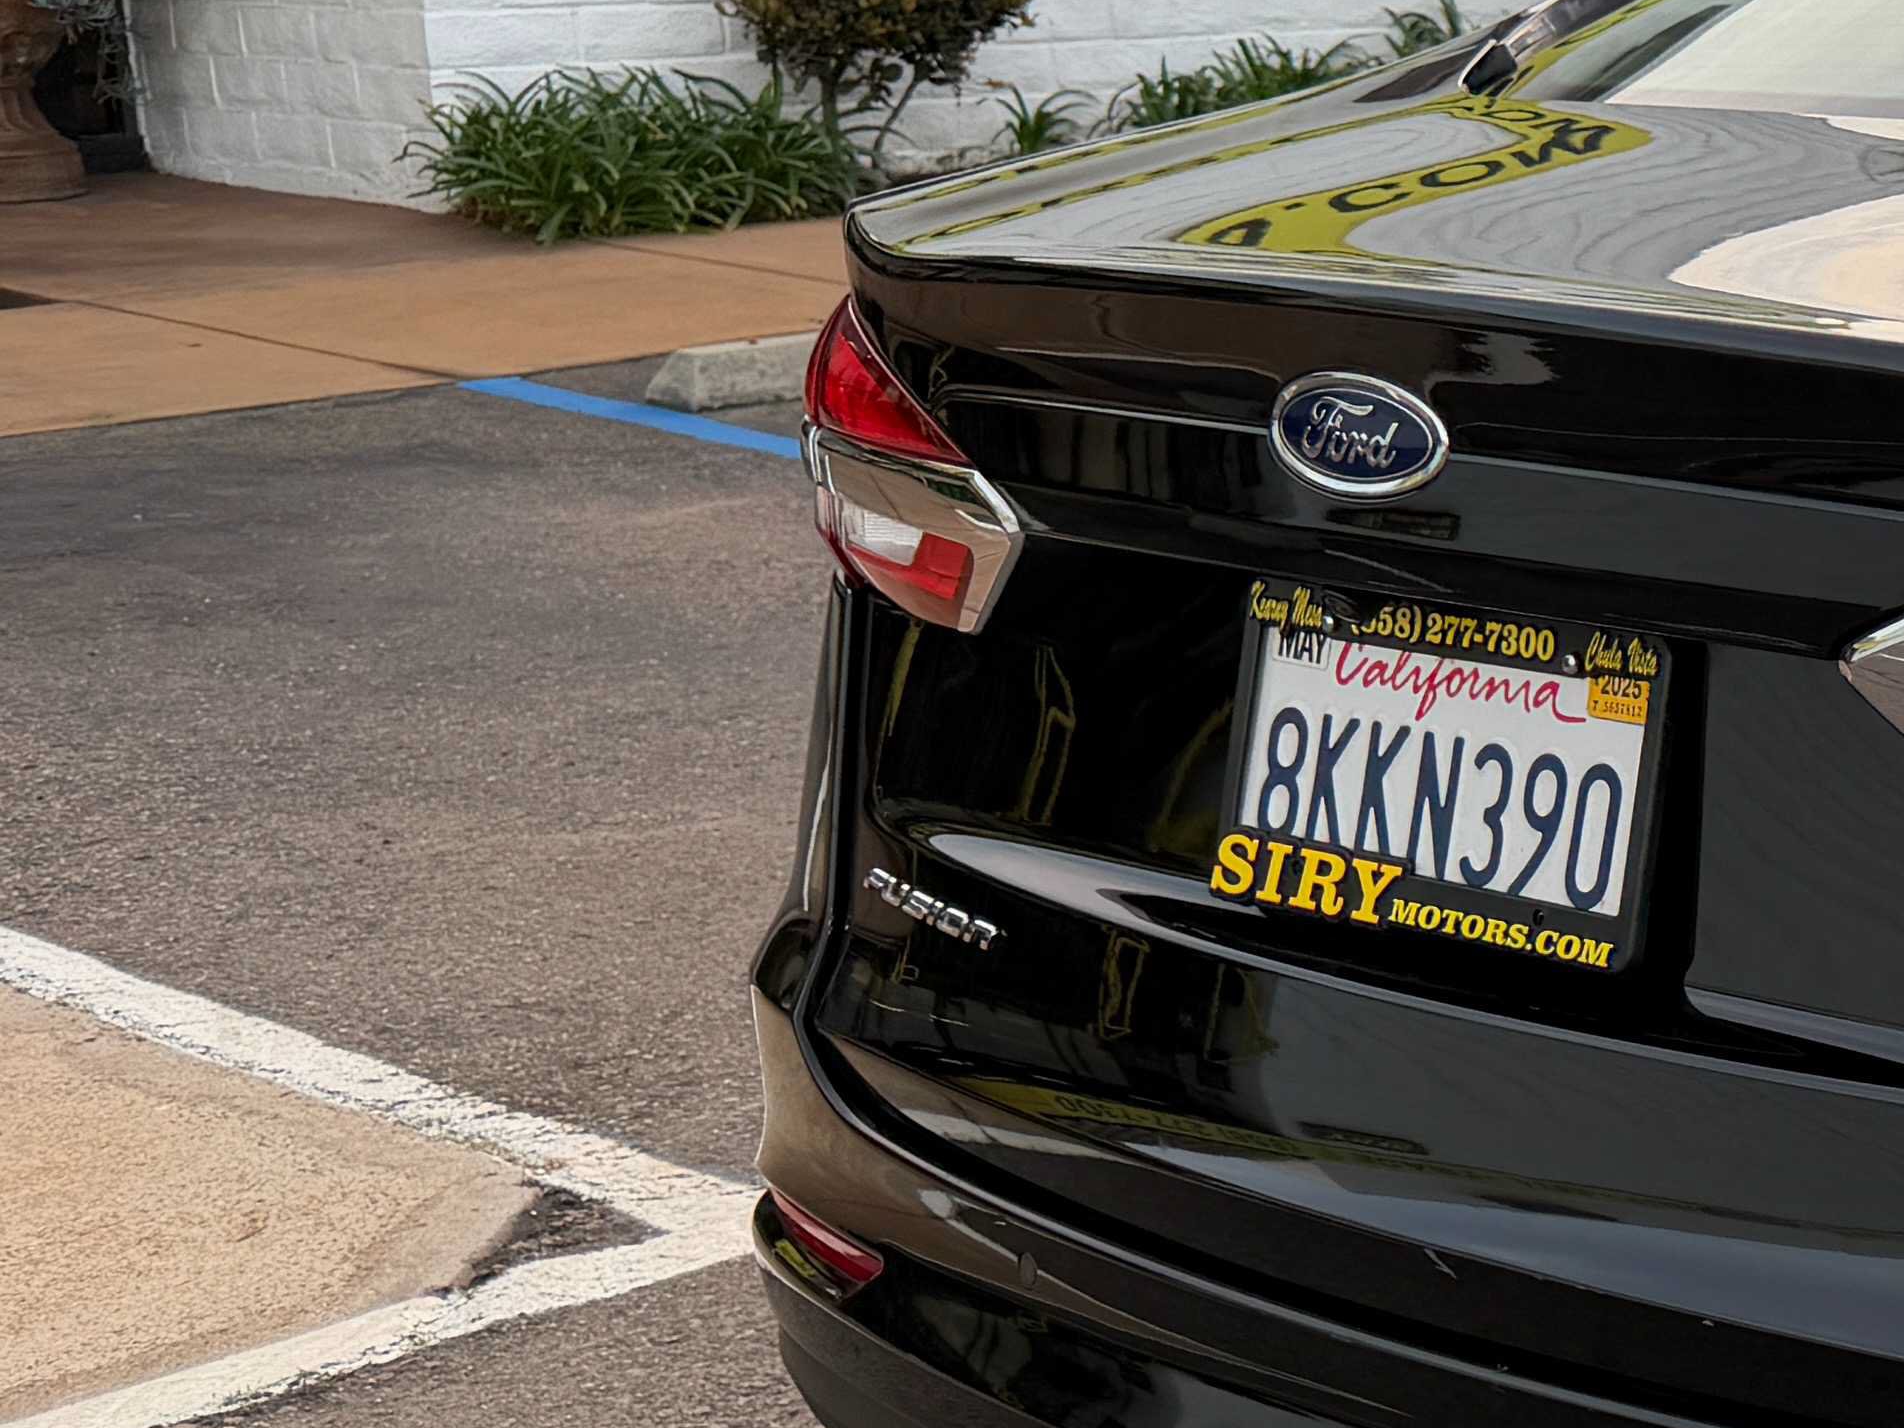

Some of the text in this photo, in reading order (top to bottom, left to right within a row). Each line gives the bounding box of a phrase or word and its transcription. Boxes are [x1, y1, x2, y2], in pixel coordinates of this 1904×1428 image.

[1302, 396, 1399, 469] Ford
[1278, 630, 1326, 665] MAY
[1351, 603, 1556, 663] 58) 277-7300
[1335, 640, 1587, 723] California
[1601, 674, 1642, 700] 2025
[1257, 706, 1624, 913] 8KKN390
[863, 867, 1000, 951] FUSION
[1209, 831, 1615, 969] SIRY MOTORS.COM
